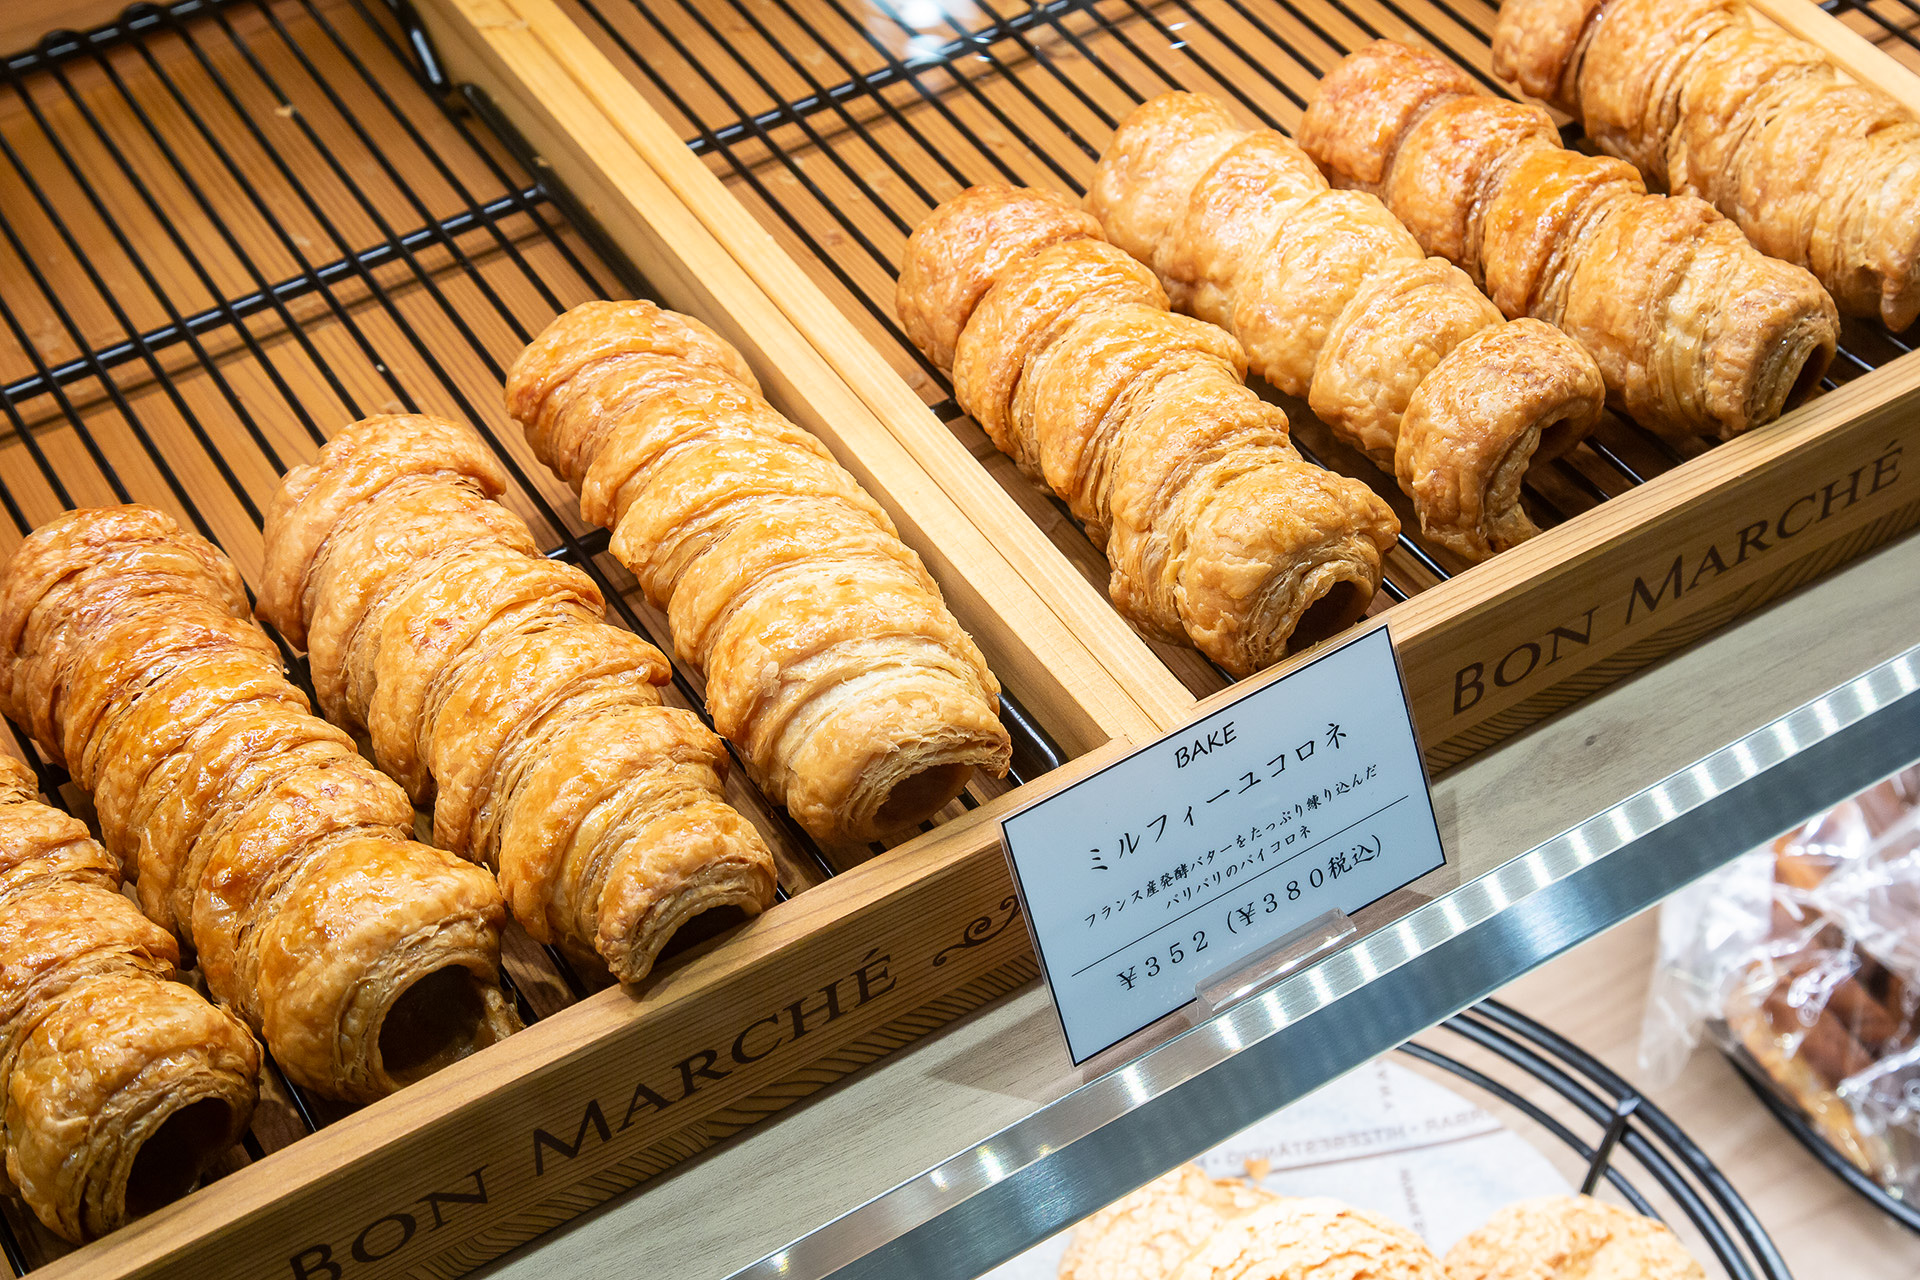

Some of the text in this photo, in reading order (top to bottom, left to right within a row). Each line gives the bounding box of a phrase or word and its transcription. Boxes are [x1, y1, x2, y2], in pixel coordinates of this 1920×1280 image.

[1453, 439, 1904, 716] BON MARCHÉ
[1089, 723, 1347, 871] ミルフィーユコロネ
[1174, 721, 1238, 768] BAKE
[1084, 764, 1377, 928] フランス産発酵バターをたっぷり練り込んだ
[1166, 825, 1311, 909] パリパリのパイコロネ
[1116, 930, 1209, 991] ¥352
[289, 948, 898, 1280] BON MARCHÉ
